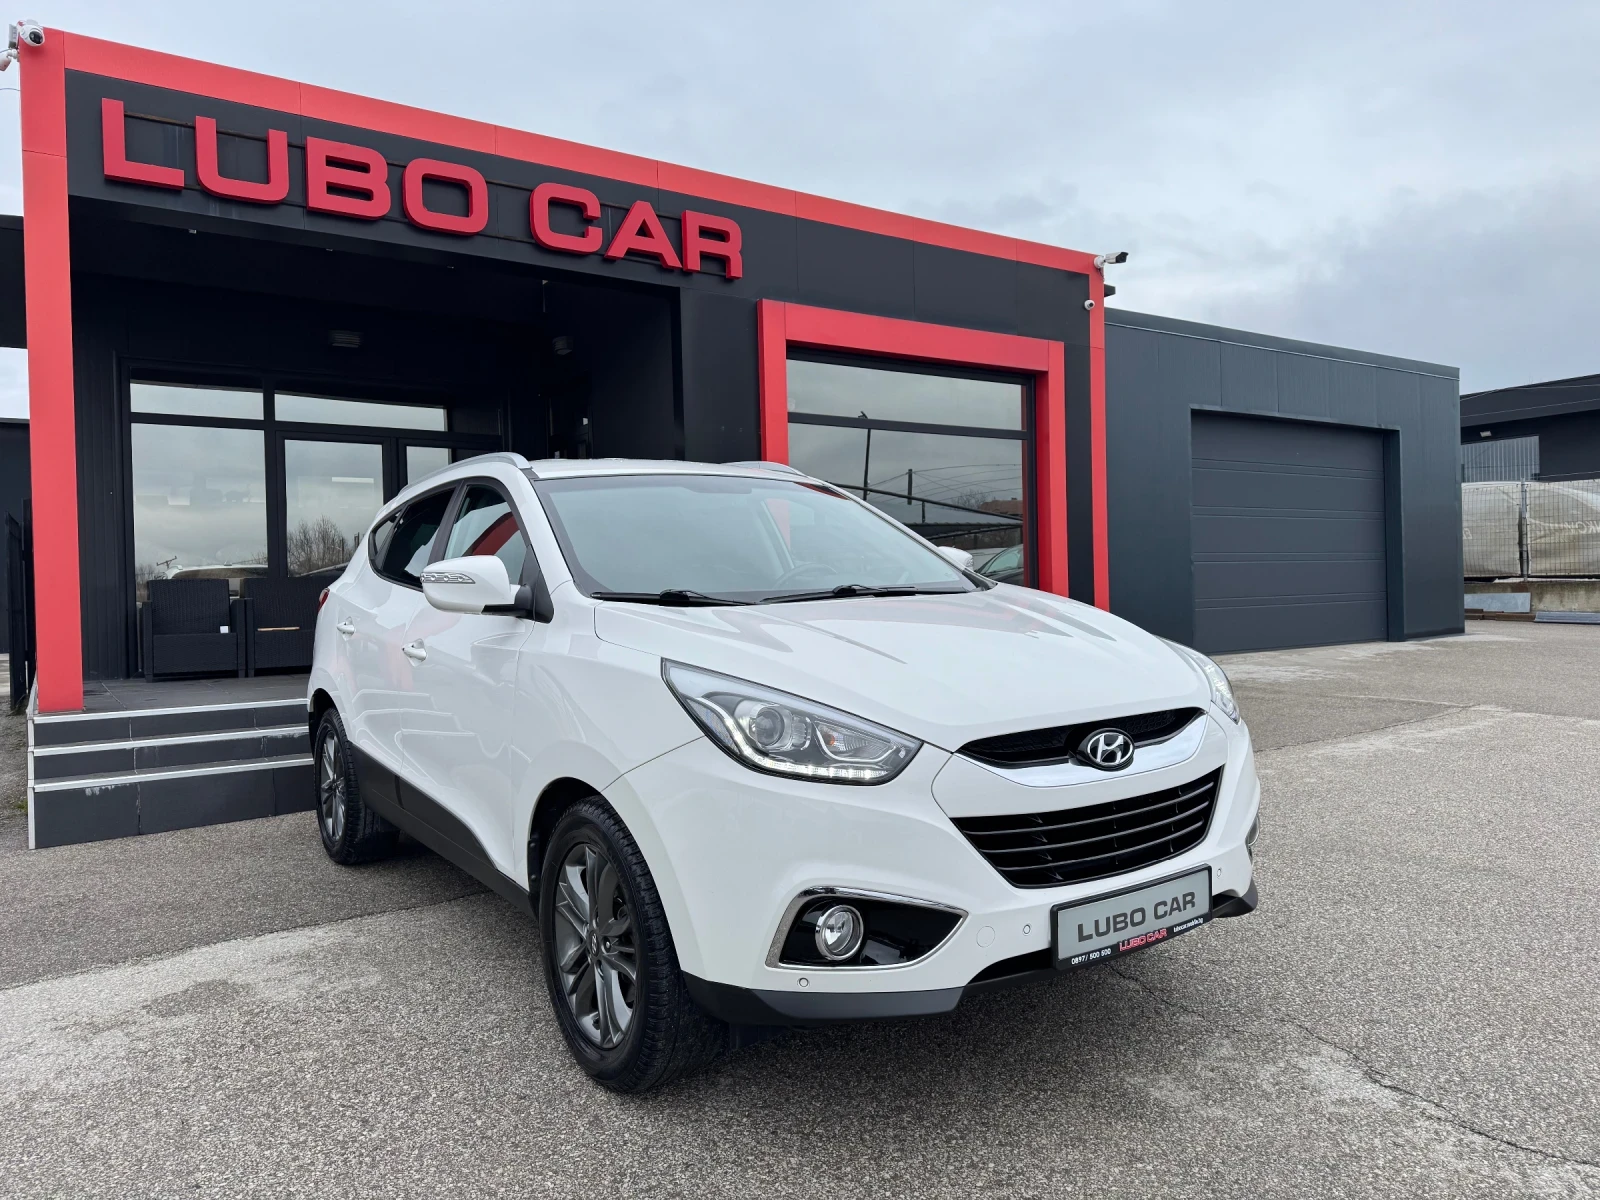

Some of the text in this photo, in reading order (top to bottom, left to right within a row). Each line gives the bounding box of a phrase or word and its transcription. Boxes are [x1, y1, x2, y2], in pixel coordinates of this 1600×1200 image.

[101, 97, 743, 281] LUBO CAR
[1077, 891, 1196, 943] LUBO CAR
[1119, 928, 1168, 952] LUBO CAR
